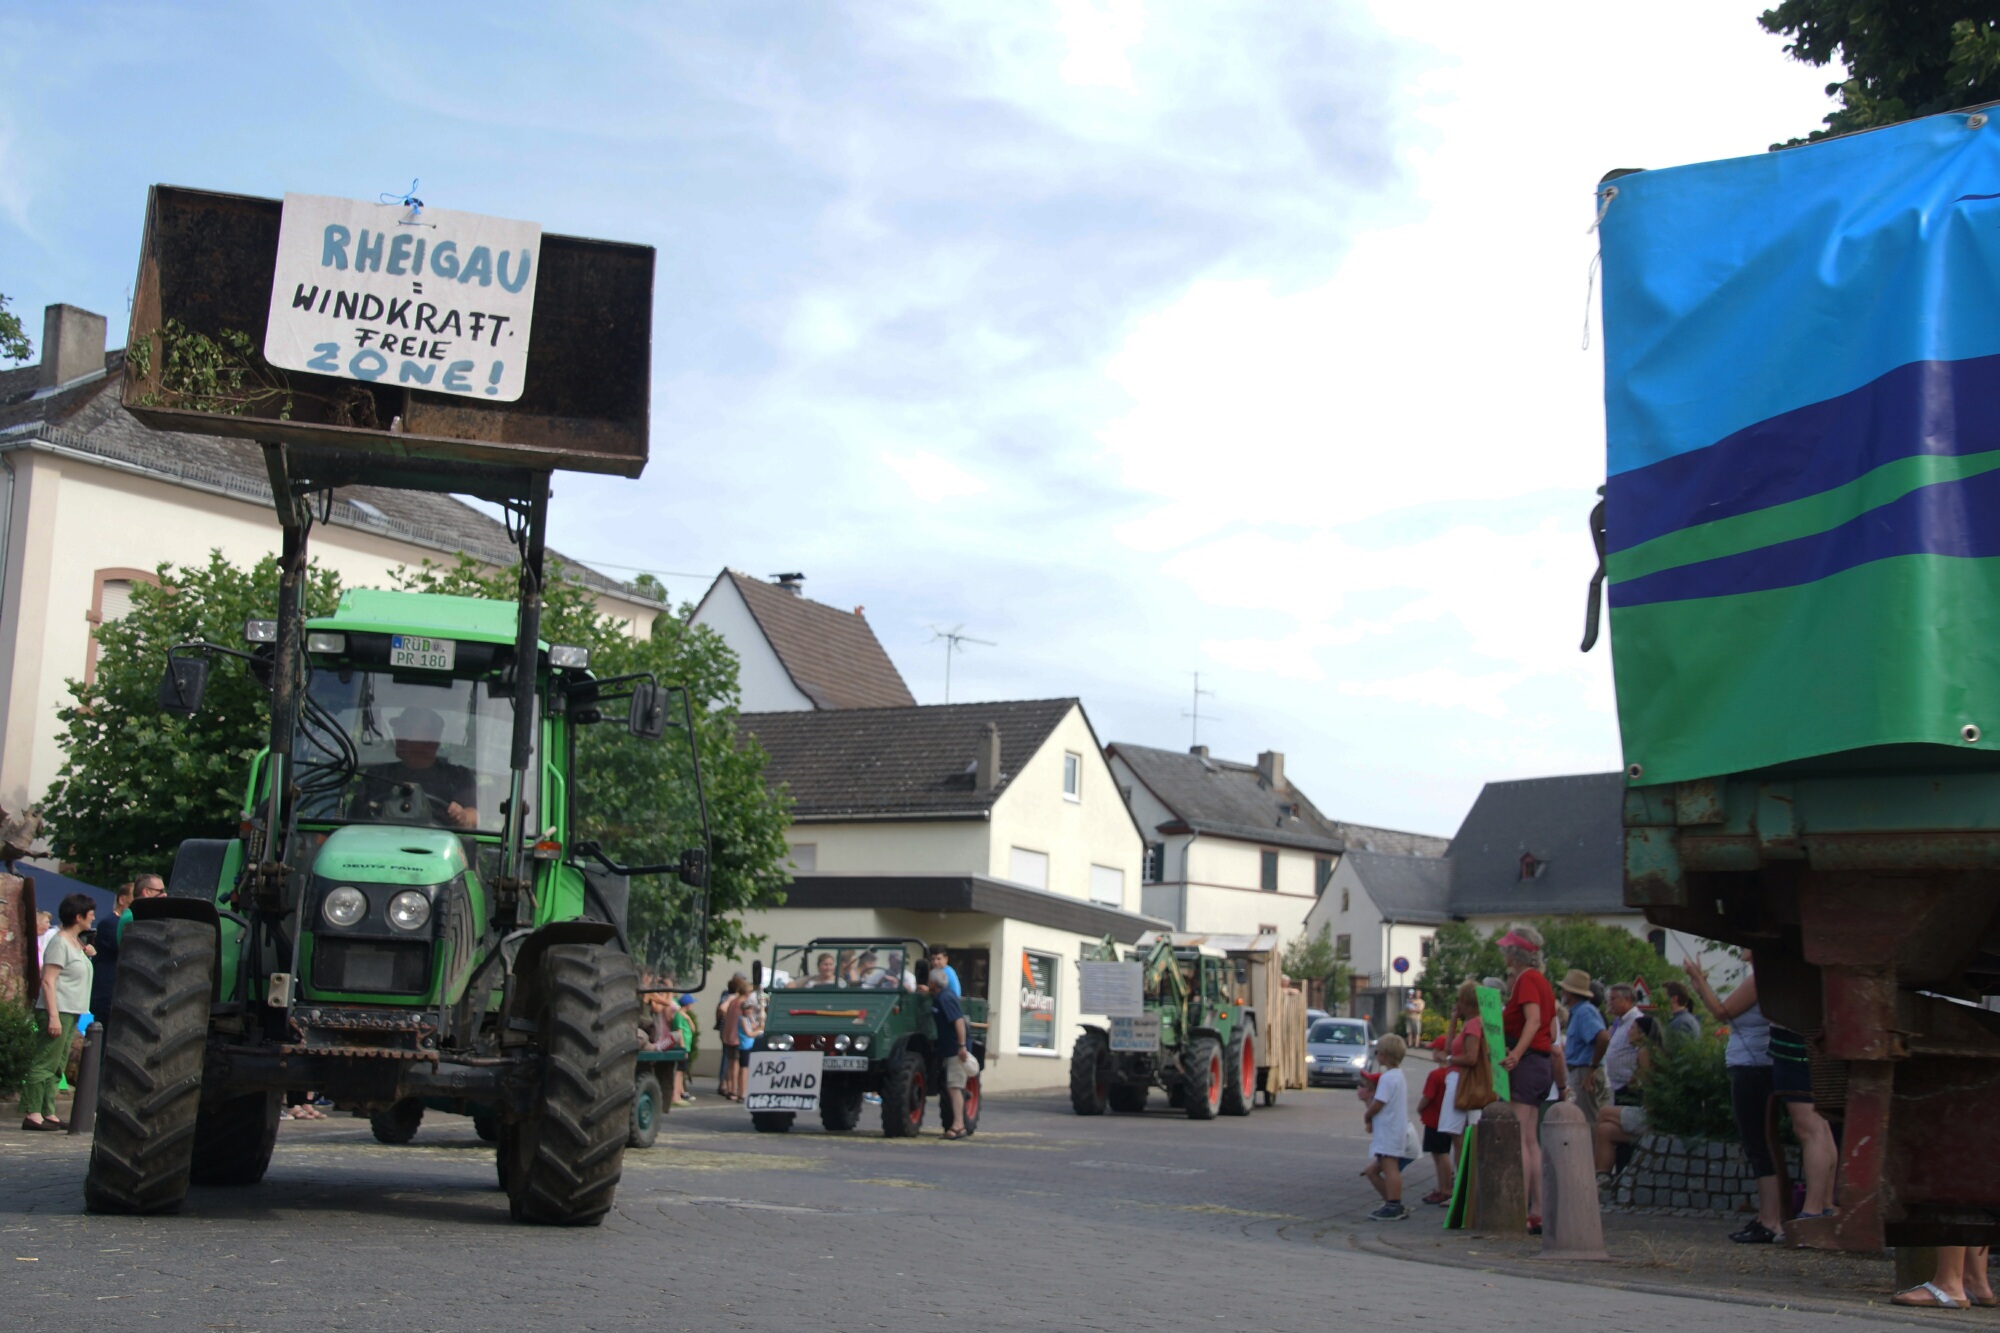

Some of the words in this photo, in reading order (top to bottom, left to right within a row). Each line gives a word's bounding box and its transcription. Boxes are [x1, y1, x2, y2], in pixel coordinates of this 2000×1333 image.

[321, 224, 531, 293] RHEIGAU
[354, 327, 452, 361] FREIE
[306, 342, 504, 395] ZONE!
[397, 652, 415, 665] PR
[420, 654, 447, 668] 180
[752, 1061, 786, 1077] ABO
[770, 1073, 816, 1089] WIND
